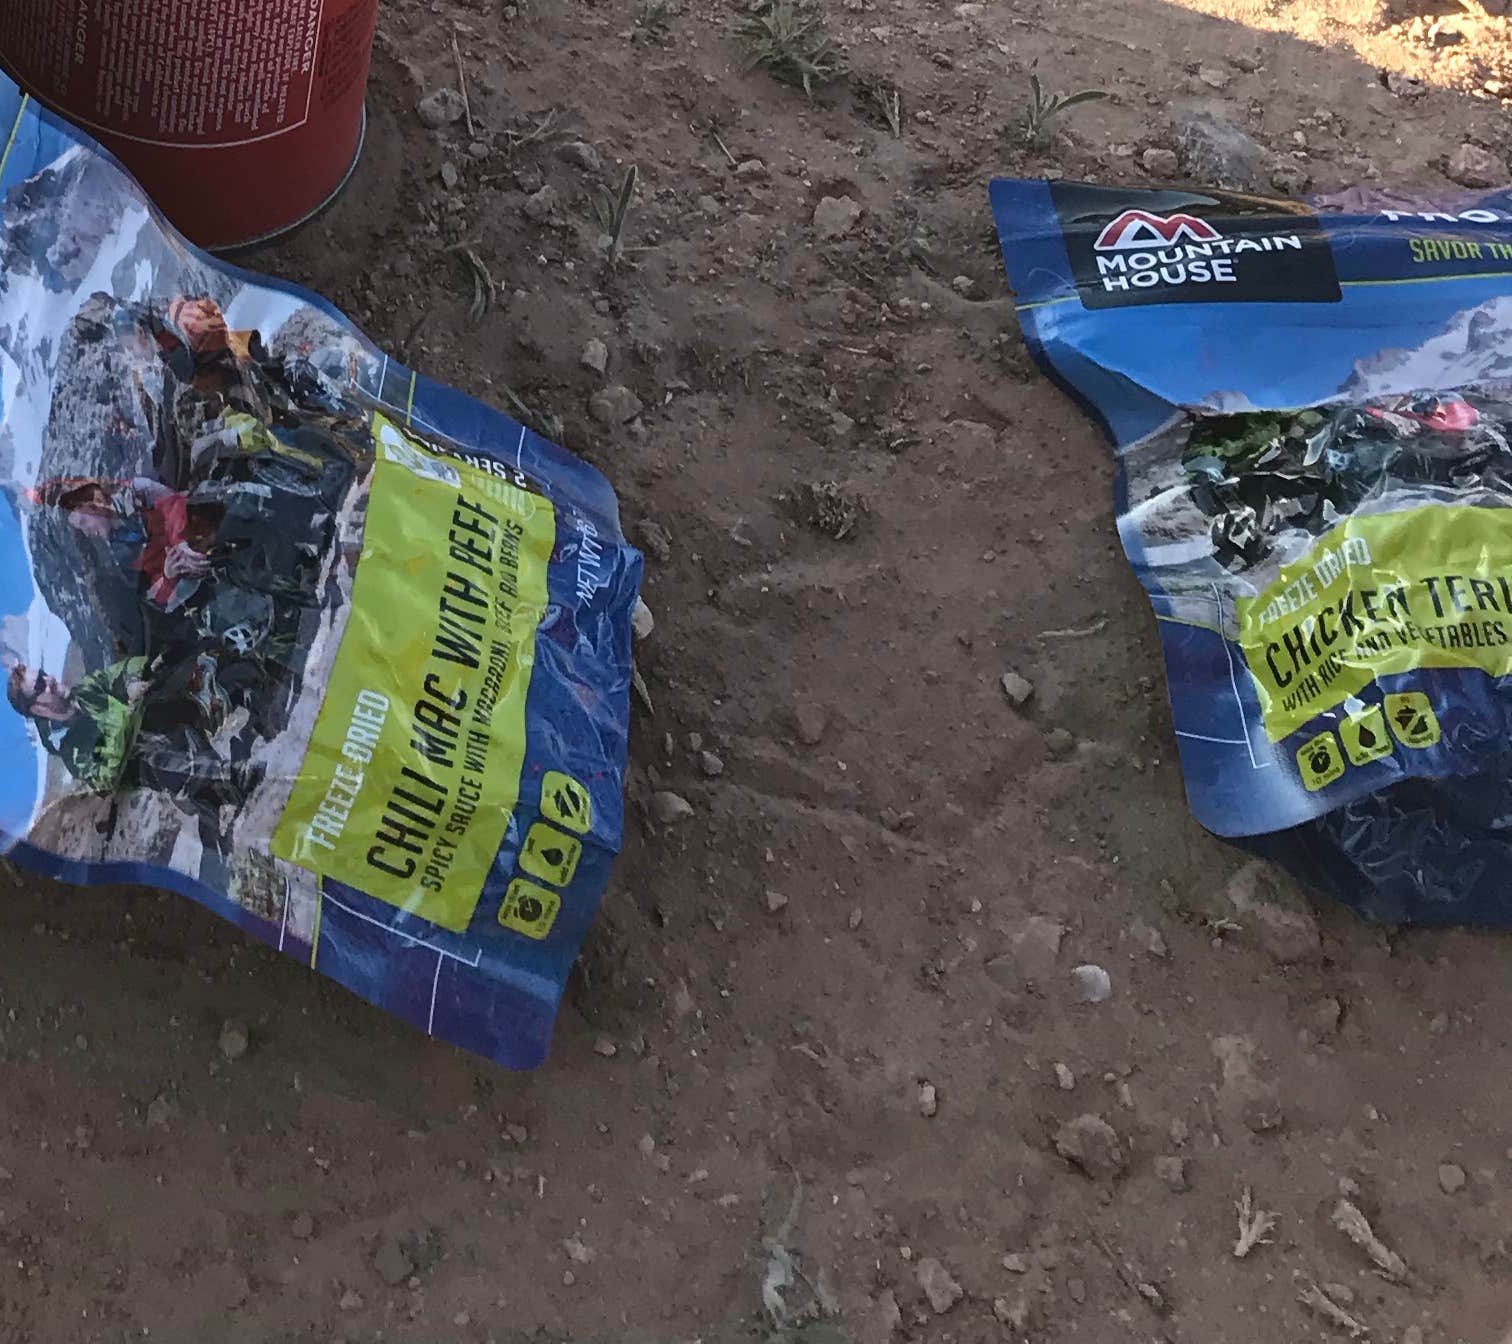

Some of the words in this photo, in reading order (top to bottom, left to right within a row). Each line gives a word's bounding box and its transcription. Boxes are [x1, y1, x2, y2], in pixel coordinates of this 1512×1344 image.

[1096, 235, 1302, 275] MOUNTAIN
[1102, 259, 1237, 292] HOUSE
[1409, 238, 1483, 263] SAVOR
[431, 570, 490, 669] WITH
[1266, 587, 1412, 689] CHICKEN
[1282, 672, 1322, 713] WITH
[410, 672, 467, 769] MAC
[463, 729, 490, 775] WITH
[366, 767, 448, 878] CHILI
[446, 775, 483, 837] SAUCE
[420, 838, 454, 893] SPICY
